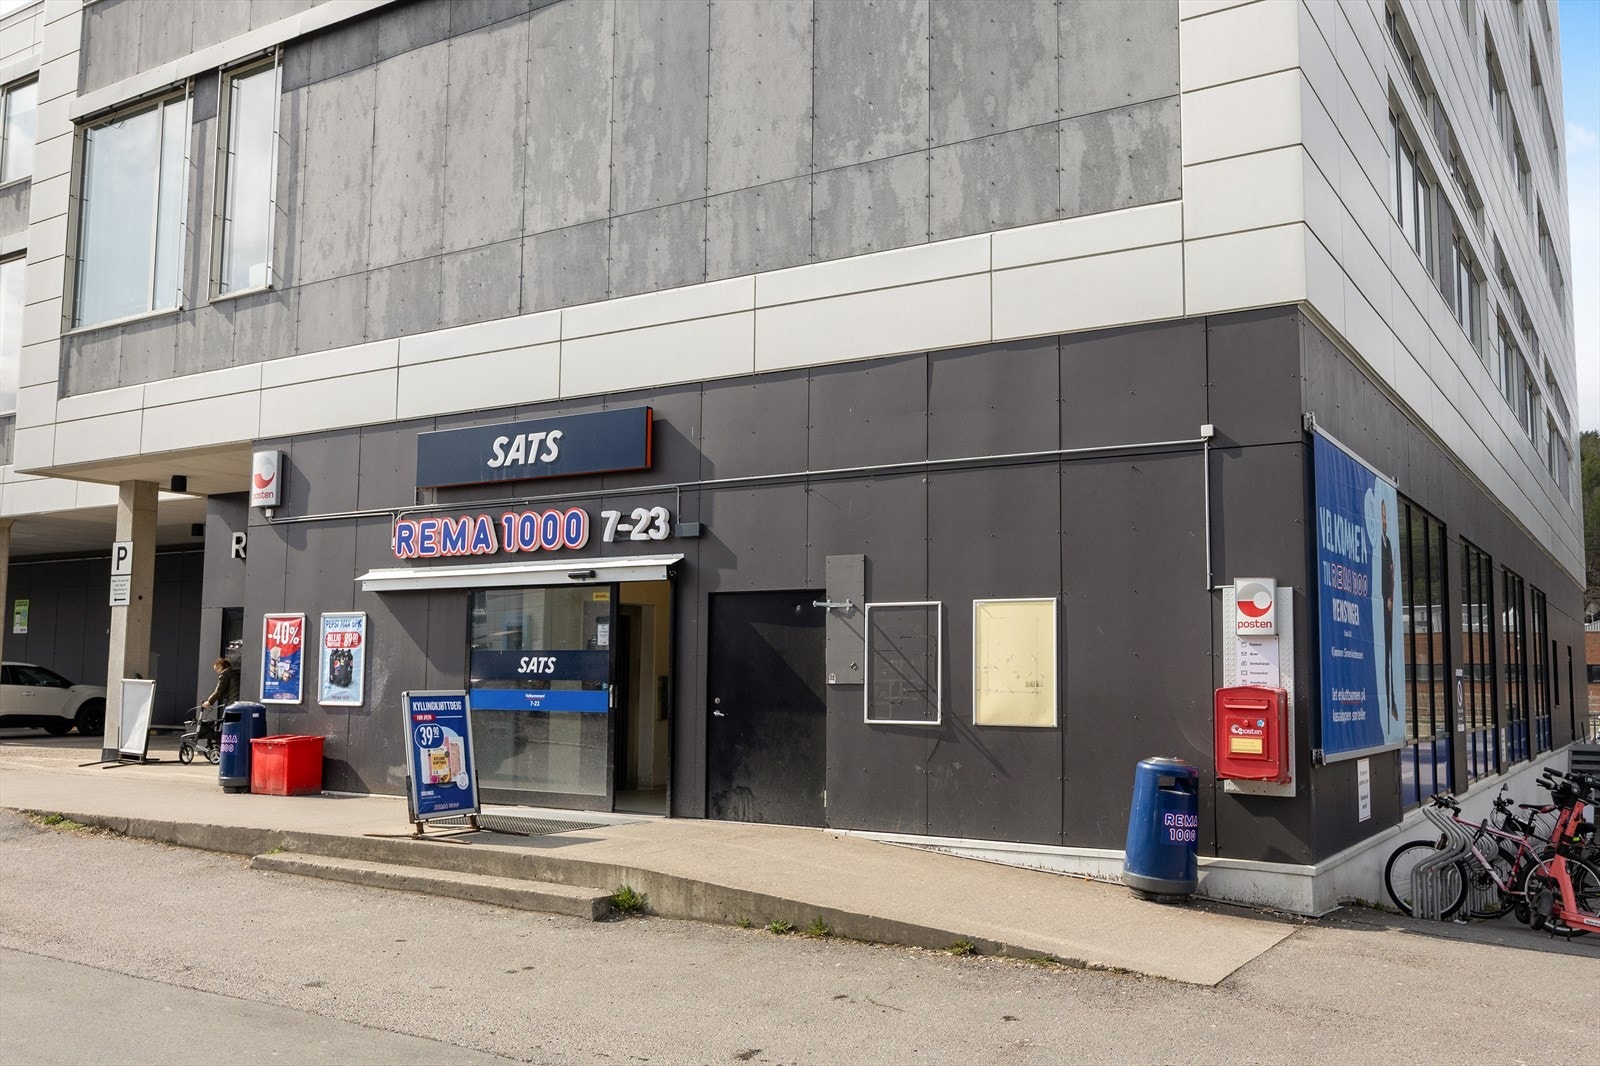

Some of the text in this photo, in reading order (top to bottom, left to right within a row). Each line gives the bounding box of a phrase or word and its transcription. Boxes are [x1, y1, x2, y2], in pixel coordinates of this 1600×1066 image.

[487, 429, 563, 469] SATS
[253, 490, 274, 500] posten
[393, 506, 670, 560] REMA 1000 7-23
[1319, 506, 1368, 564] VELKOMMEN
[231, 531, 247, 559] R
[116, 546, 128, 571] P
[1323, 560, 1368, 597] TIL REMA 1000
[267, 621, 299, 645] -40%
[1238, 619, 1272, 630] posten
[343, 633, 352, 647] 89
[517, 656, 557, 674] SATS
[412, 700, 462, 711] KYLLINGKJØTTDEIG
[221, 734, 238, 744] EMA
[419, 726, 440, 746] 39 90
[1164, 812, 1198, 827] REMA
[1169, 829, 1196, 842] 1000
